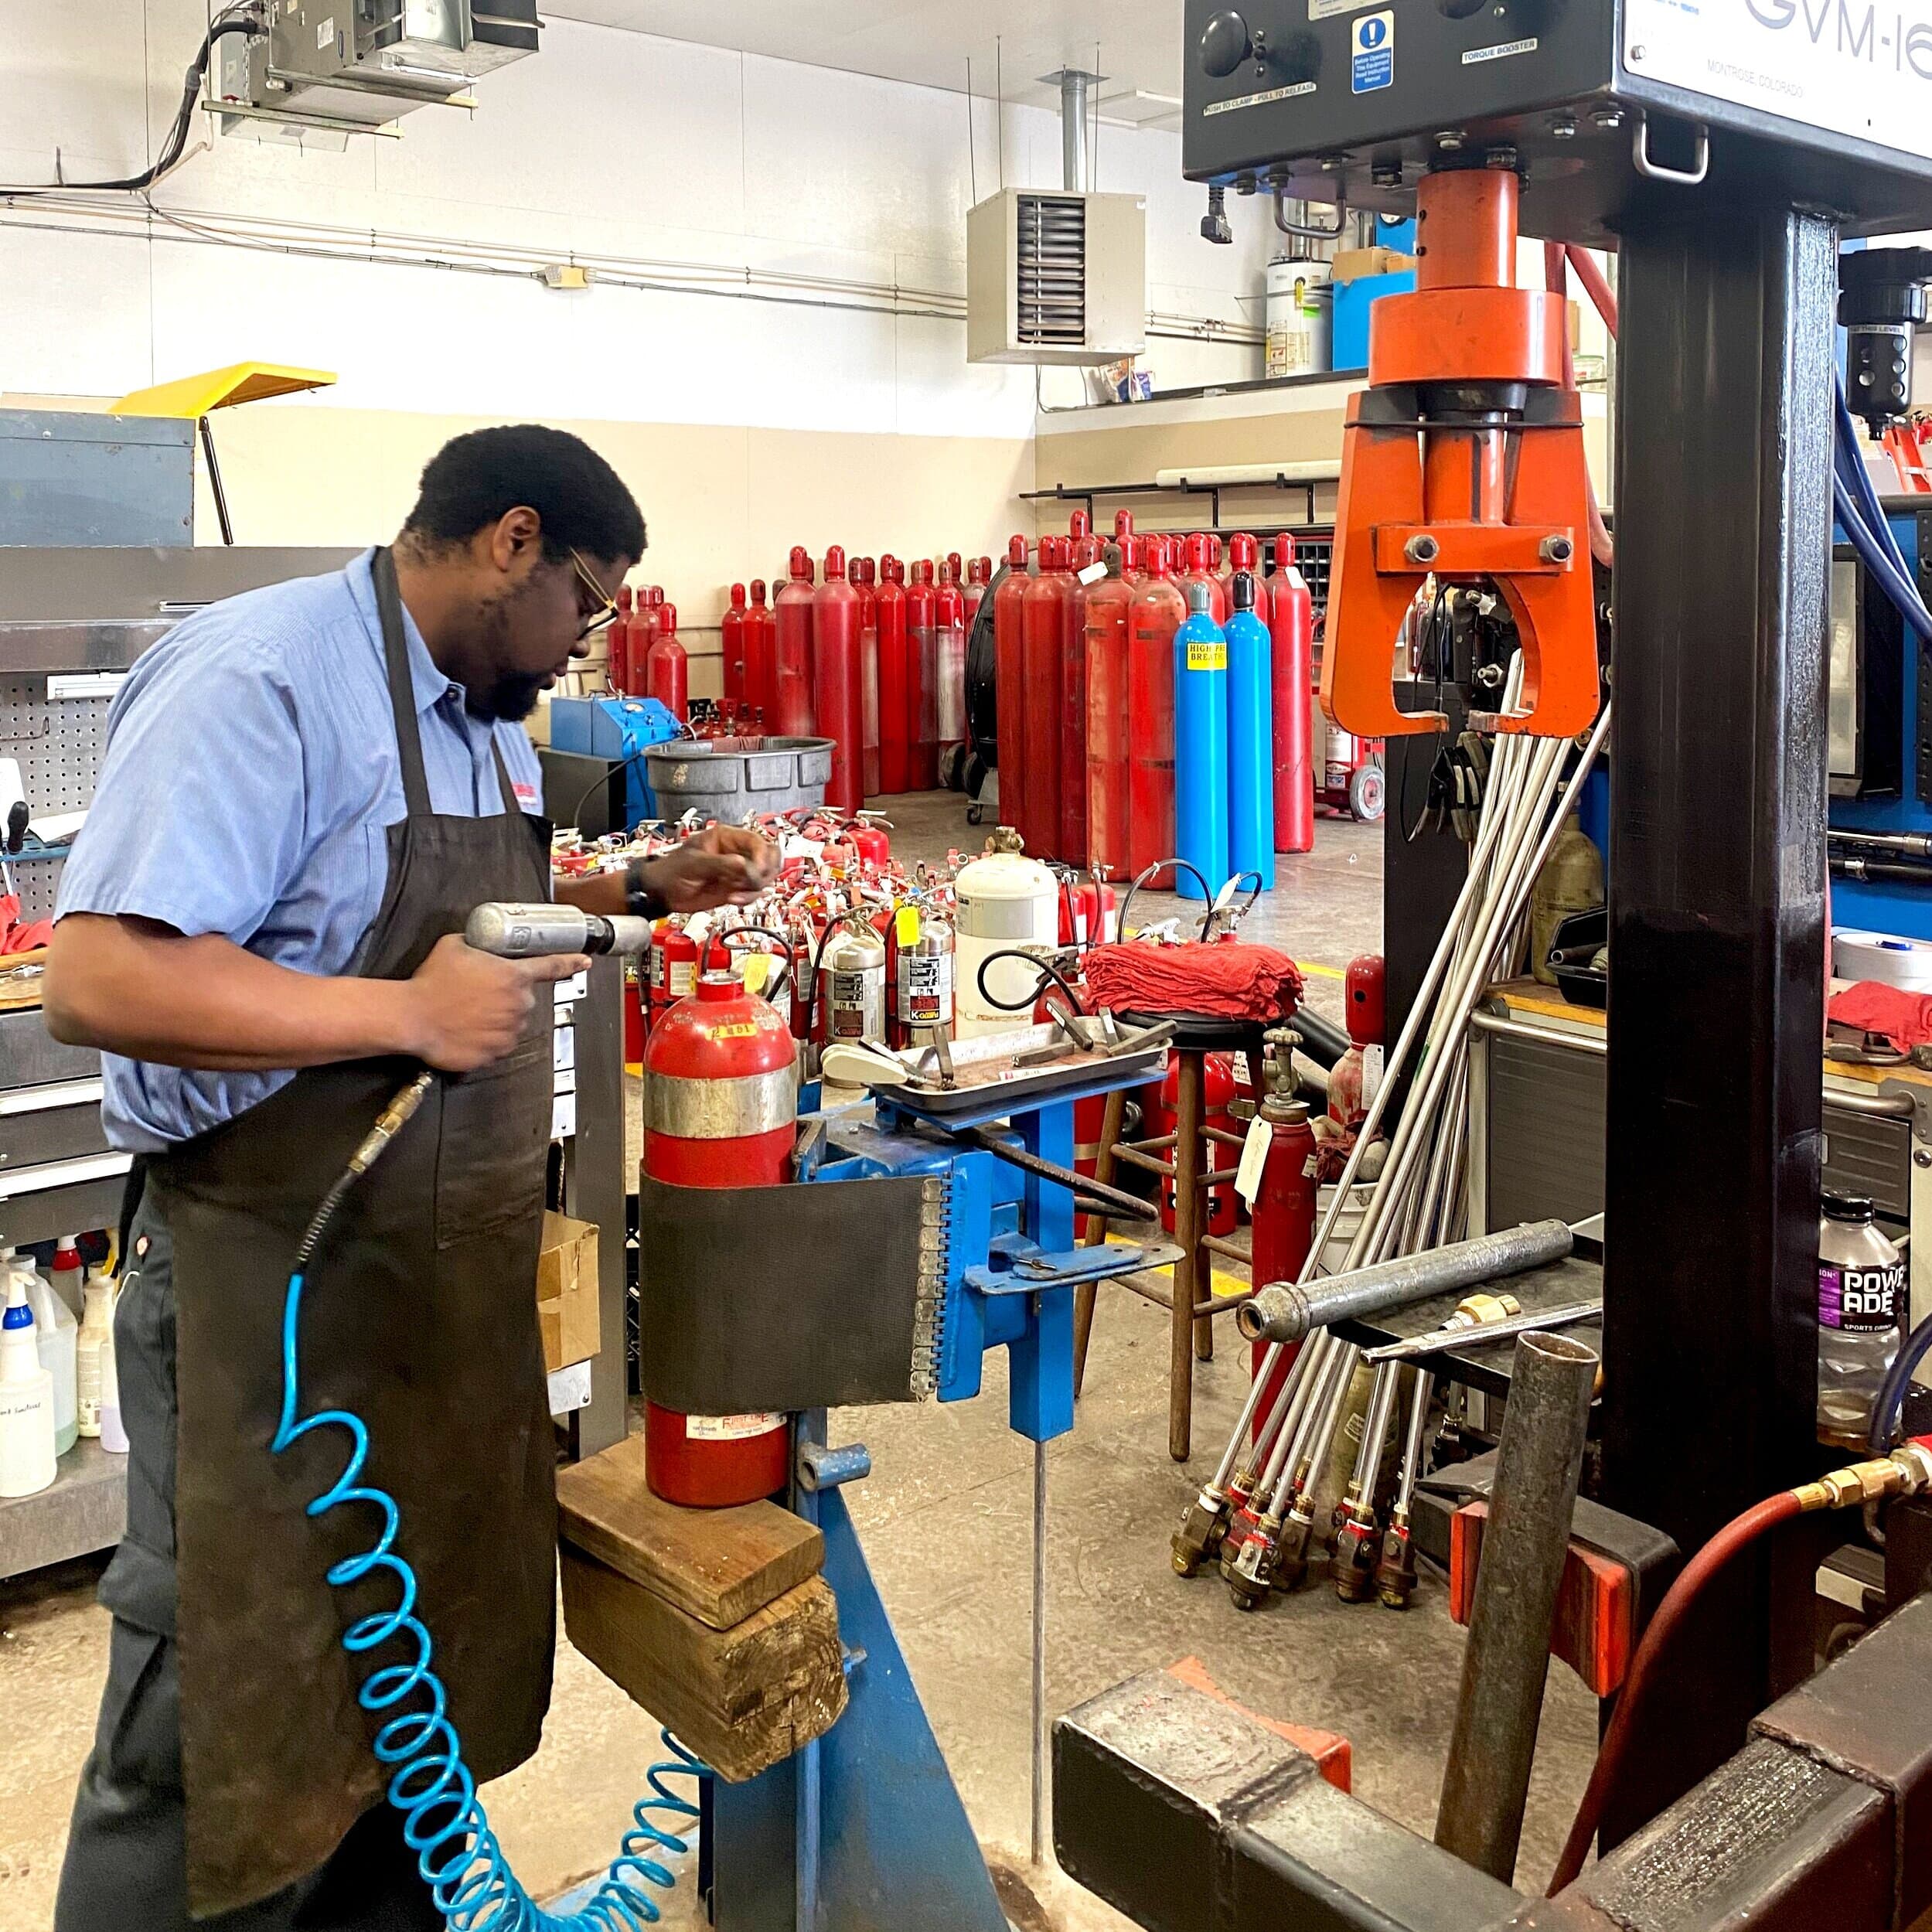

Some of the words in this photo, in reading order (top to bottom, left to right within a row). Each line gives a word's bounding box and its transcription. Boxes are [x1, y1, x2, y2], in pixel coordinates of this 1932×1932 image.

[1463, 49, 1495, 62] TORQUE
[1497, 39, 1535, 55] BOOSTER
[1205, 104, 1222, 114] PUSH
[1232, 97, 1253, 107] CLAMP
[1258, 93, 1273, 101] PULL
[1285, 82, 1315, 96] RELEASE
[1759, 74, 1804, 98] COLORADO
[1844, 1292, 1894, 1316] ADE
